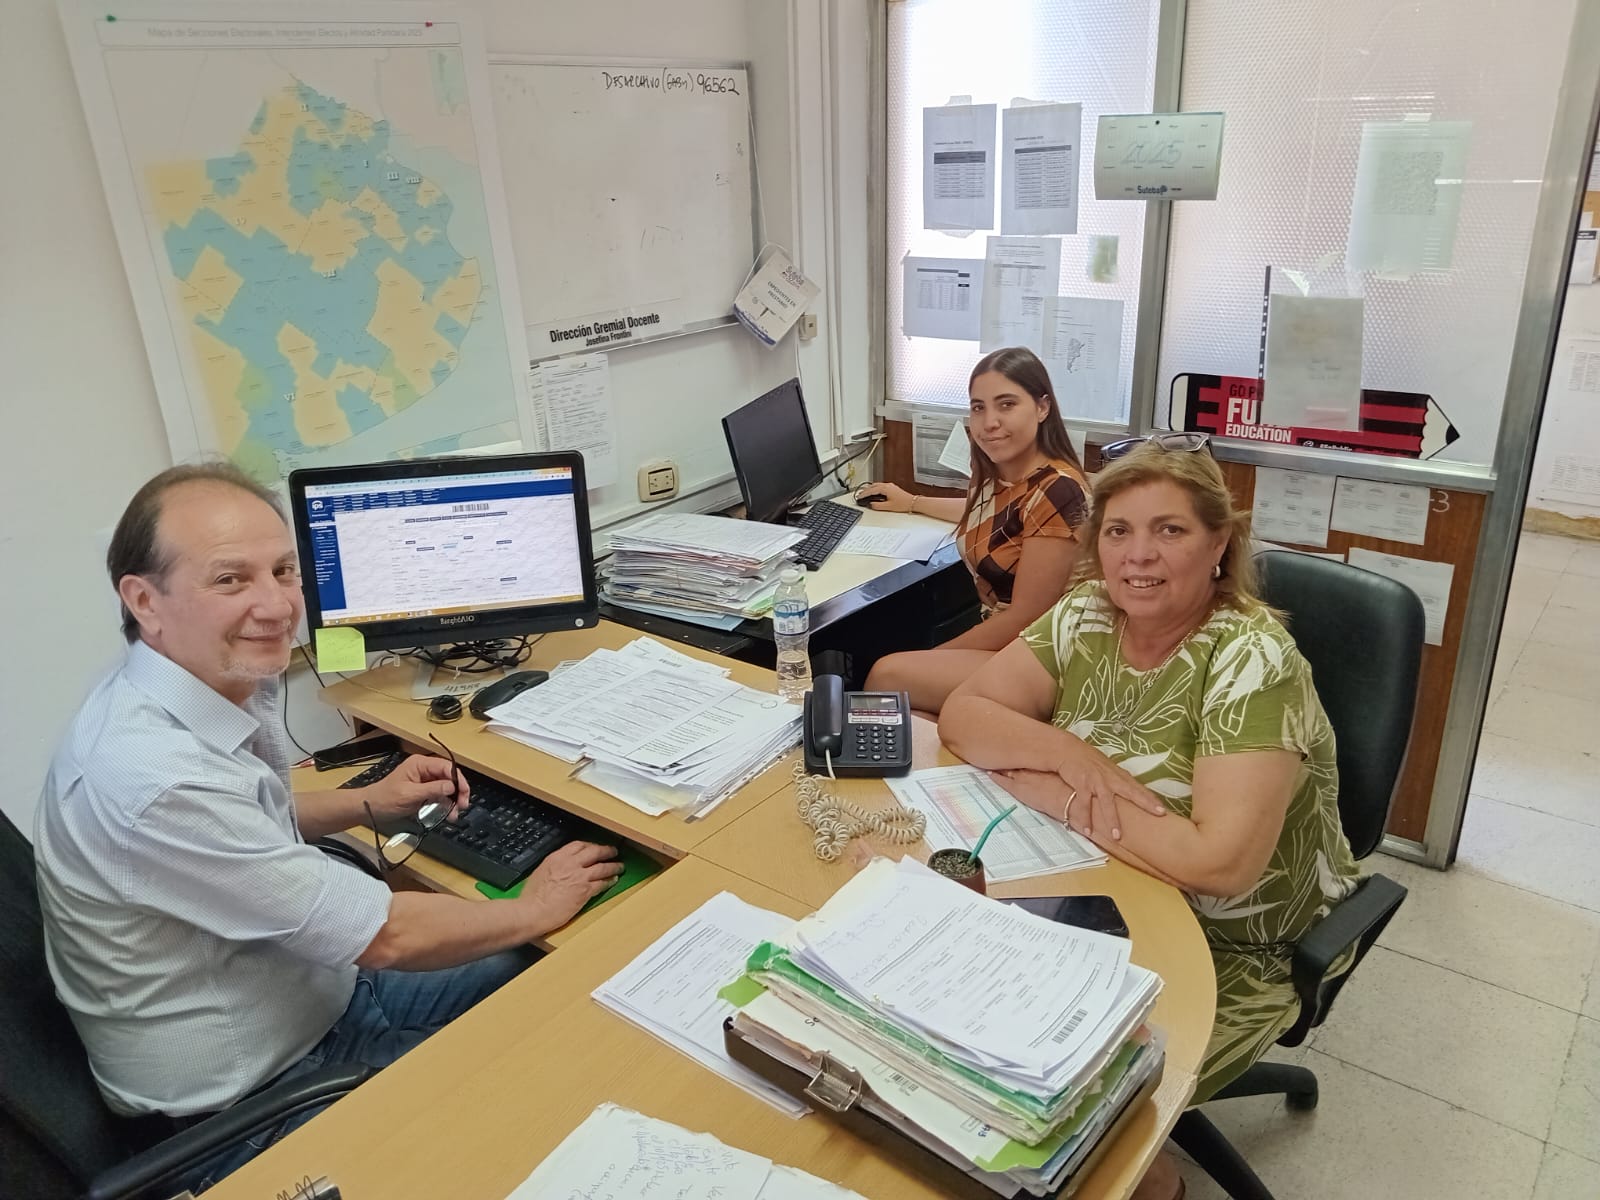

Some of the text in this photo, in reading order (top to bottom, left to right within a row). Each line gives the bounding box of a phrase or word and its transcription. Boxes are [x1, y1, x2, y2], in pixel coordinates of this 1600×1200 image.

[696, 73, 740, 96] 96562
[549, 312, 660, 343] Dirección Gremial Docente
[586, 335, 610, 347] Josefina
[1229, 383, 1246, 398] GO
[1226, 397, 1258, 426] FU
[1225, 423, 1292, 443] EDUCATION
